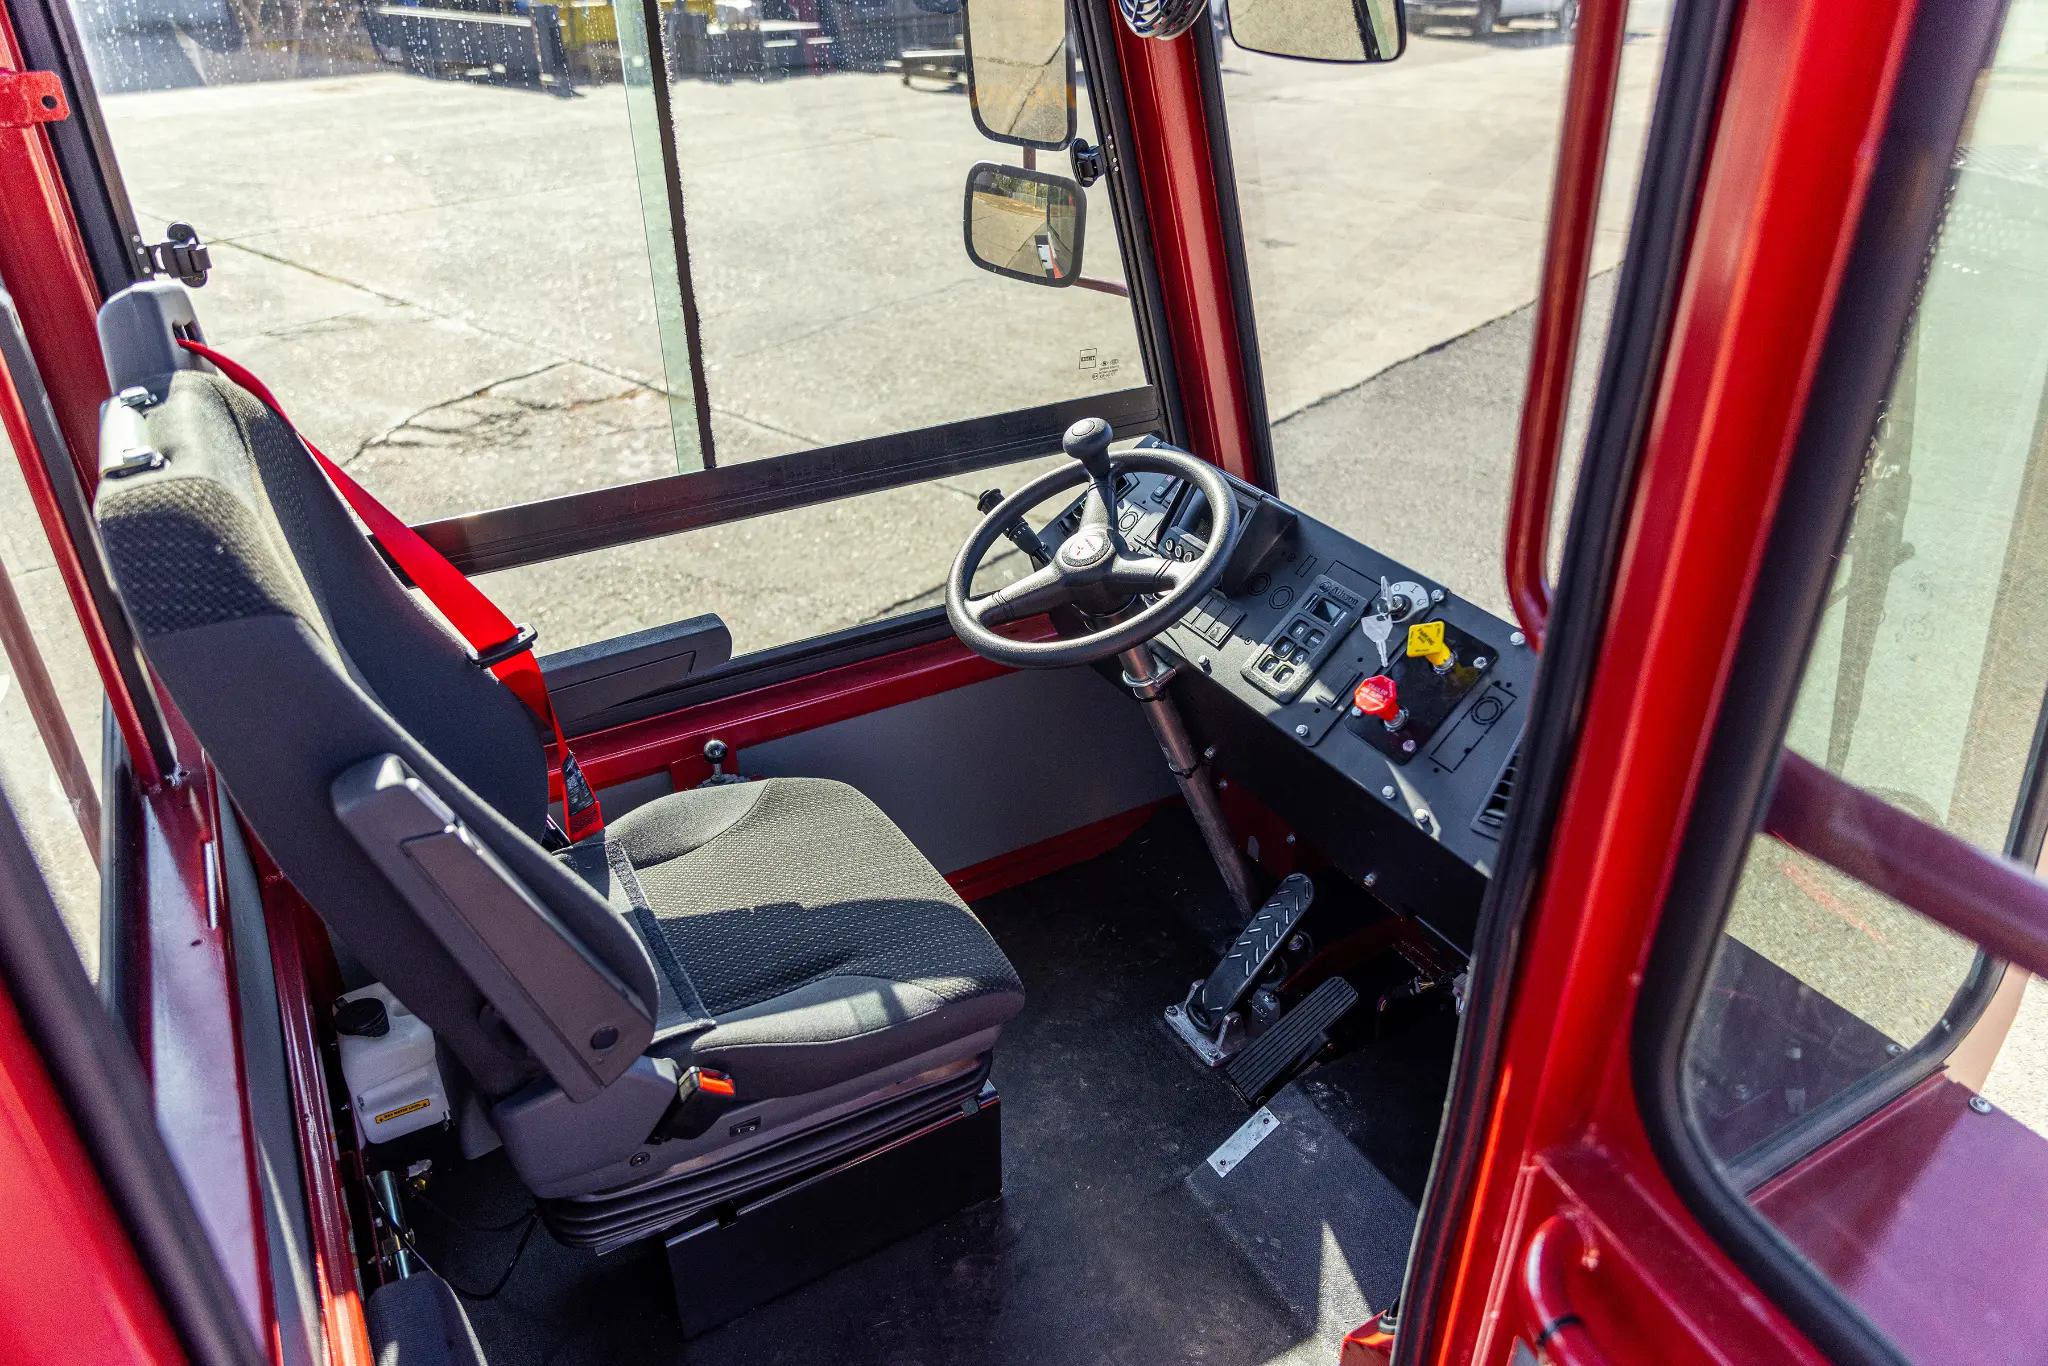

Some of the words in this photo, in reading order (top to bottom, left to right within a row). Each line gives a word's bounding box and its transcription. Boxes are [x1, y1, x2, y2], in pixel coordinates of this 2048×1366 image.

[1331, 586, 1359, 606] Allison
[1296, 626, 1304, 634] R
[1281, 644, 1289, 652] N
